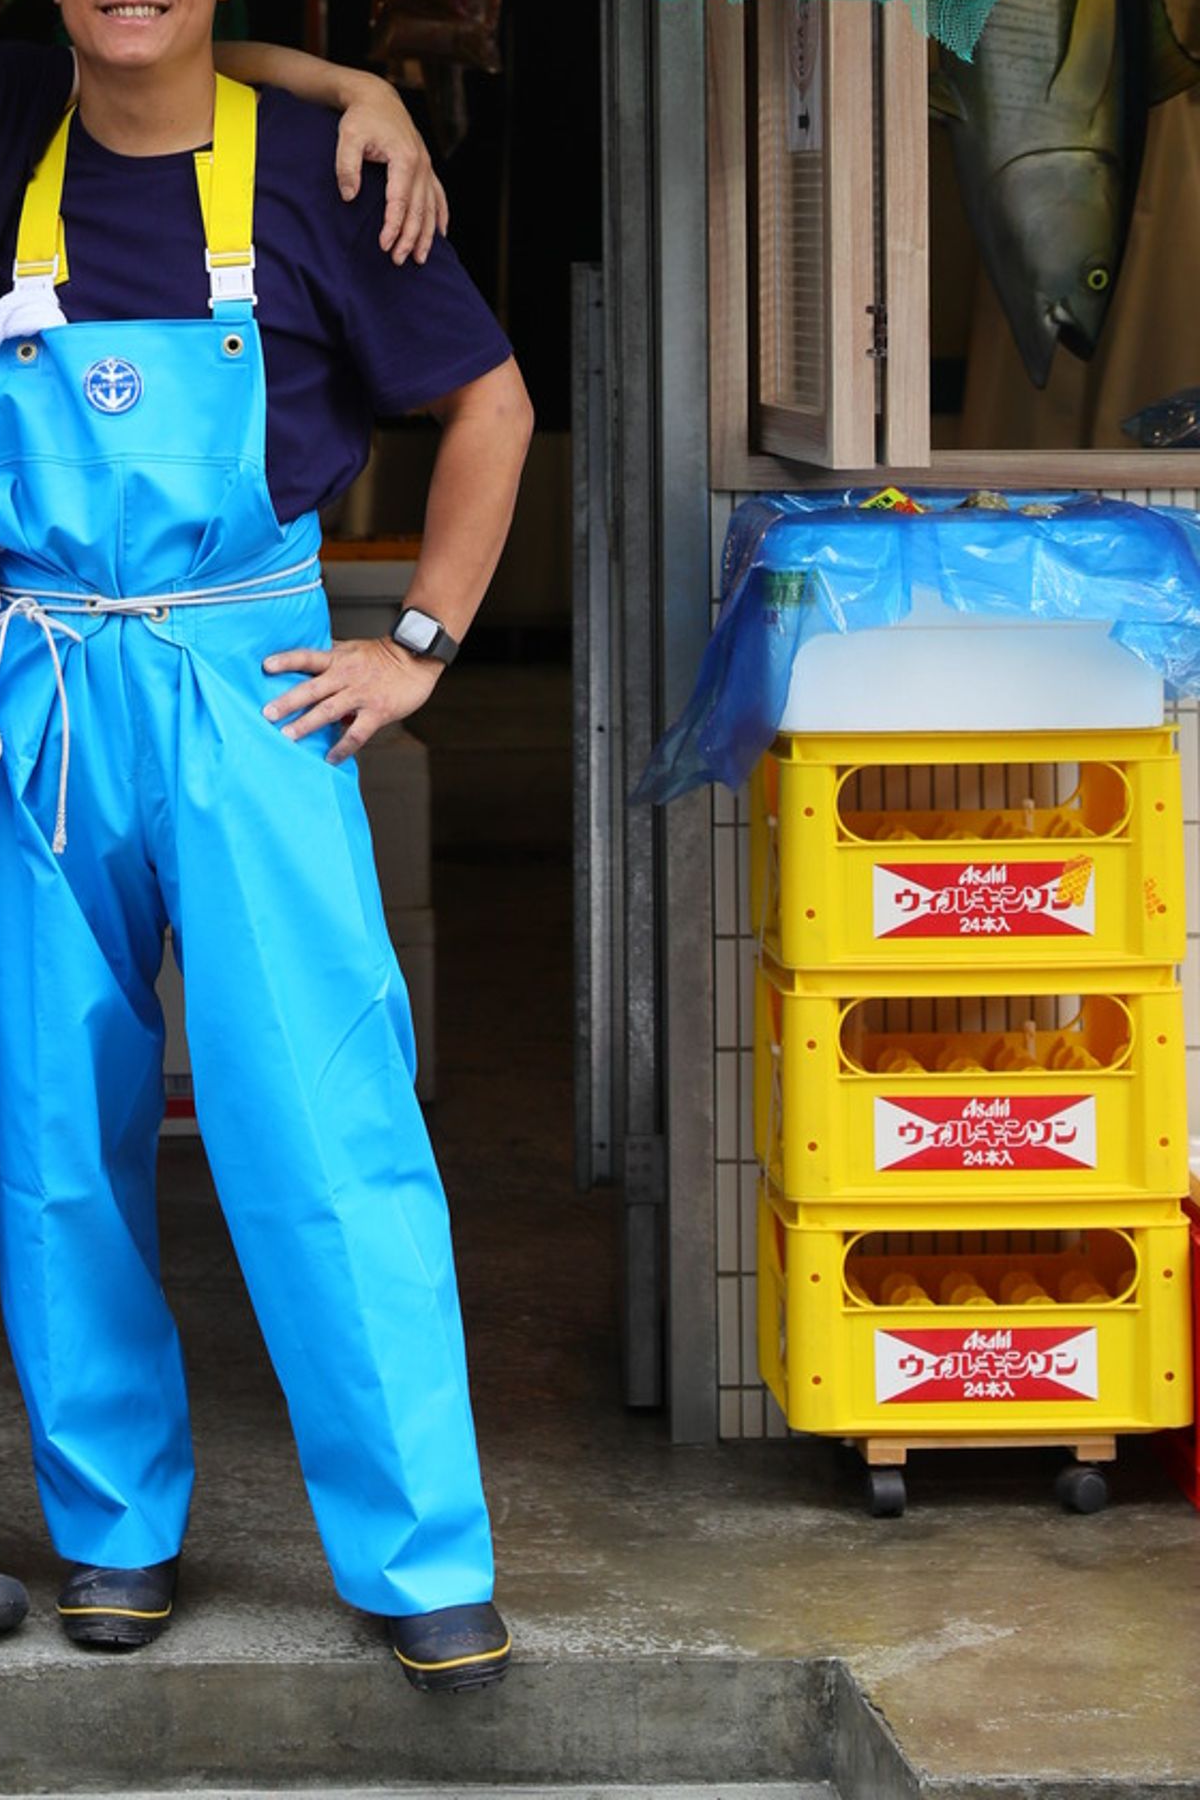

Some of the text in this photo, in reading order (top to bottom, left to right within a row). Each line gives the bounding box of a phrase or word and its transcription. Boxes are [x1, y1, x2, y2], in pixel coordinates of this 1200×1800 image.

[958, 865, 1007, 886] Asahi
[959, 916, 1012, 933] 24本入
[962, 1098, 1011, 1119] Asahi
[897, 1120, 1078, 1147] ウィルキンソン
[962, 1150, 1015, 1166] 24本入
[962, 1330, 1012, 1351] Asahi
[897, 1352, 1079, 1379] ウィルキンソン
[962, 1382, 1016, 1398] 24本入
